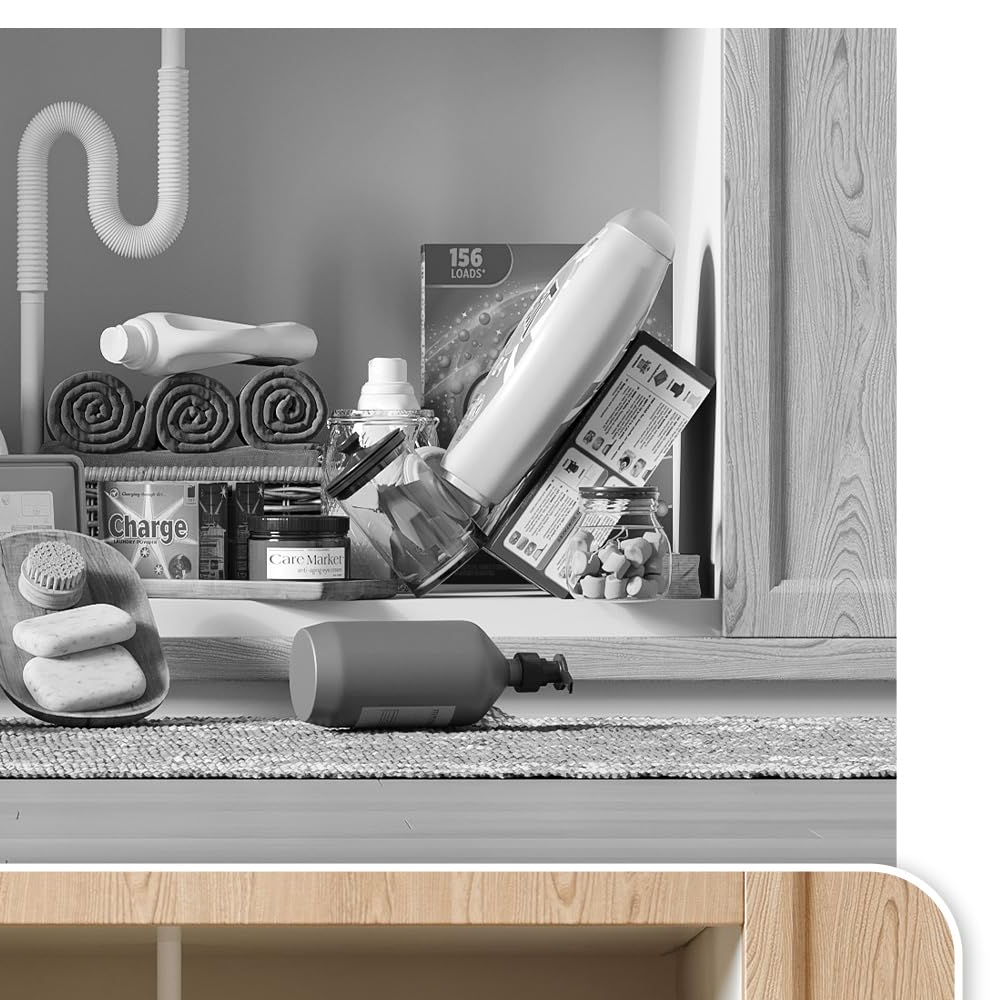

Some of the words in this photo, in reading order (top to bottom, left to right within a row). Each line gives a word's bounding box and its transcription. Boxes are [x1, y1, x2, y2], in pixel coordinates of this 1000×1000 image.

[449, 247, 483, 268] 156
[109, 513, 188, 545] Charge
[269, 553, 305, 565] Care
[306, 553, 342, 566] Market
